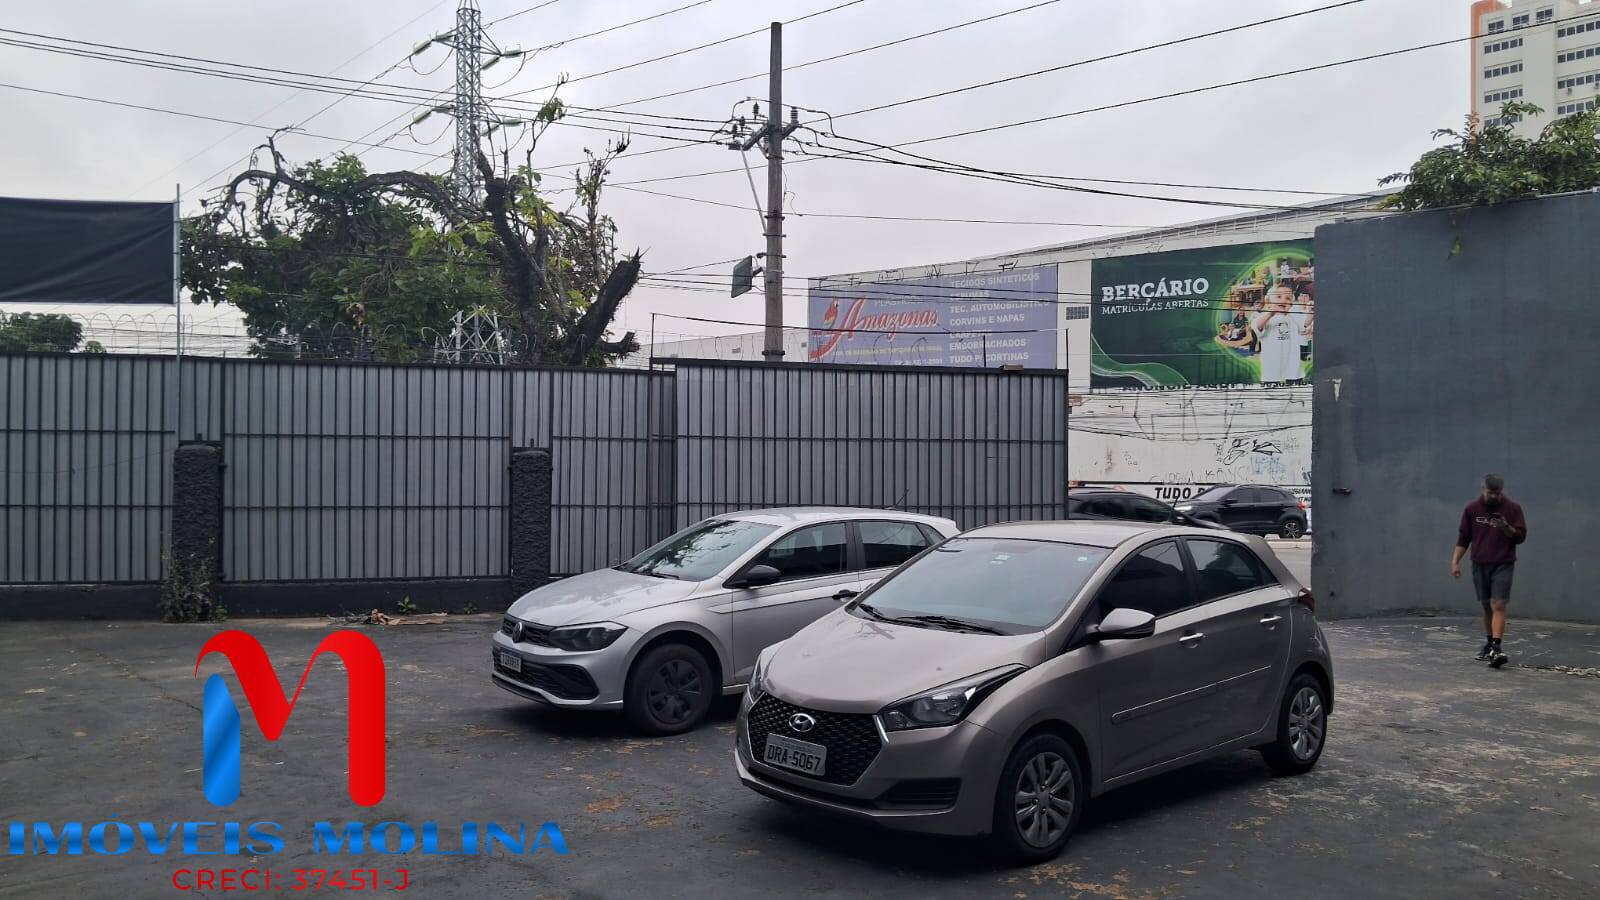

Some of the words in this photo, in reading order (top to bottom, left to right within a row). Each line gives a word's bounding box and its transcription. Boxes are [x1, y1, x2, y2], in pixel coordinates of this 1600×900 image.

[951, 276, 986, 288] TECIDOS
[1101, 277, 1209, 303] BERÇÁRIO
[1101, 302, 1163, 314] MATRÍCULAS
[1164, 299, 1209, 310] ABERTAS
[950, 316, 986, 327] CORVINS
[989, 315, 995, 324] E
[996, 314, 1025, 323] NAPAS
[950, 355, 973, 364] TUDO
[986, 352, 1030, 362] CORTINAS
[1154, 487, 1192, 500] TUDO
